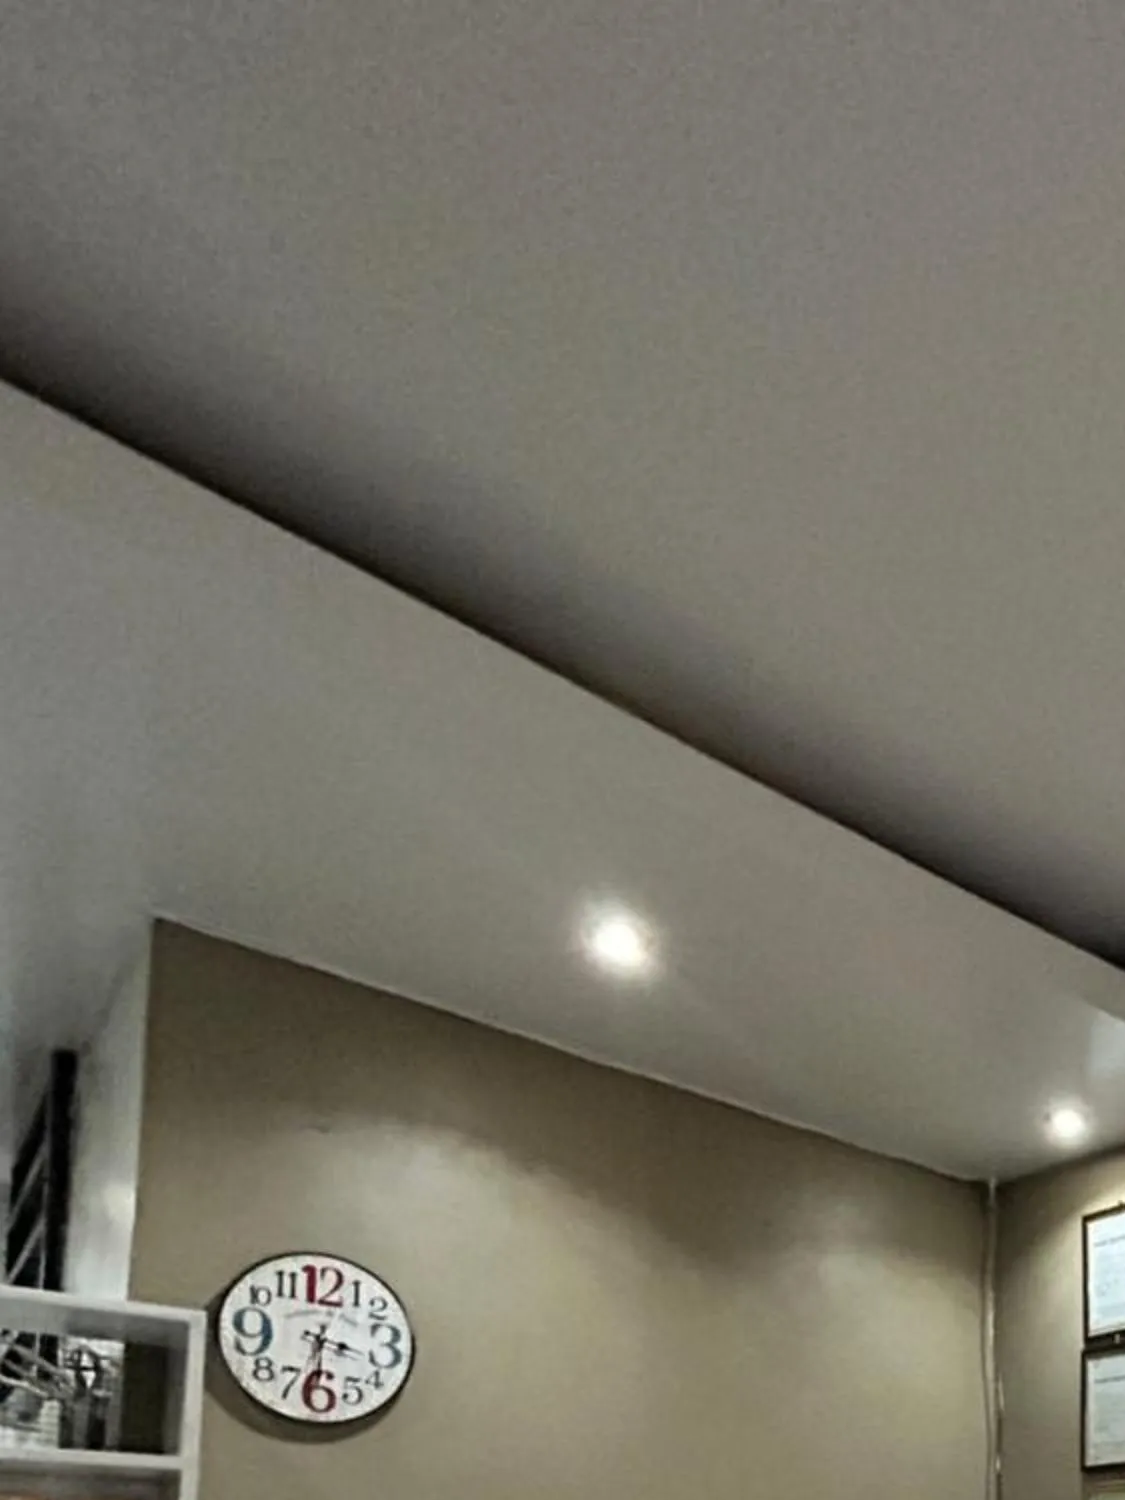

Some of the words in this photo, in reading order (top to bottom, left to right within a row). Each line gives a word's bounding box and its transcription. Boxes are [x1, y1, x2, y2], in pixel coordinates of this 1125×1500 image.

[249, 1285, 272, 1307] 10
[275, 1269, 298, 1300] 11
[302, 1264, 344, 1308] 12
[351, 1280, 361, 1308] 1
[368, 1297, 388, 1321] 2
[231, 1307, 274, 1357] 9
[368, 1323, 403, 1370] 3
[252, 1357, 275, 1382] 8
[280, 1365, 302, 1401] 7
[365, 1370, 384, 1390] 4
[301, 1369, 337, 1414] 6
[341, 1376, 363, 1406] 5
